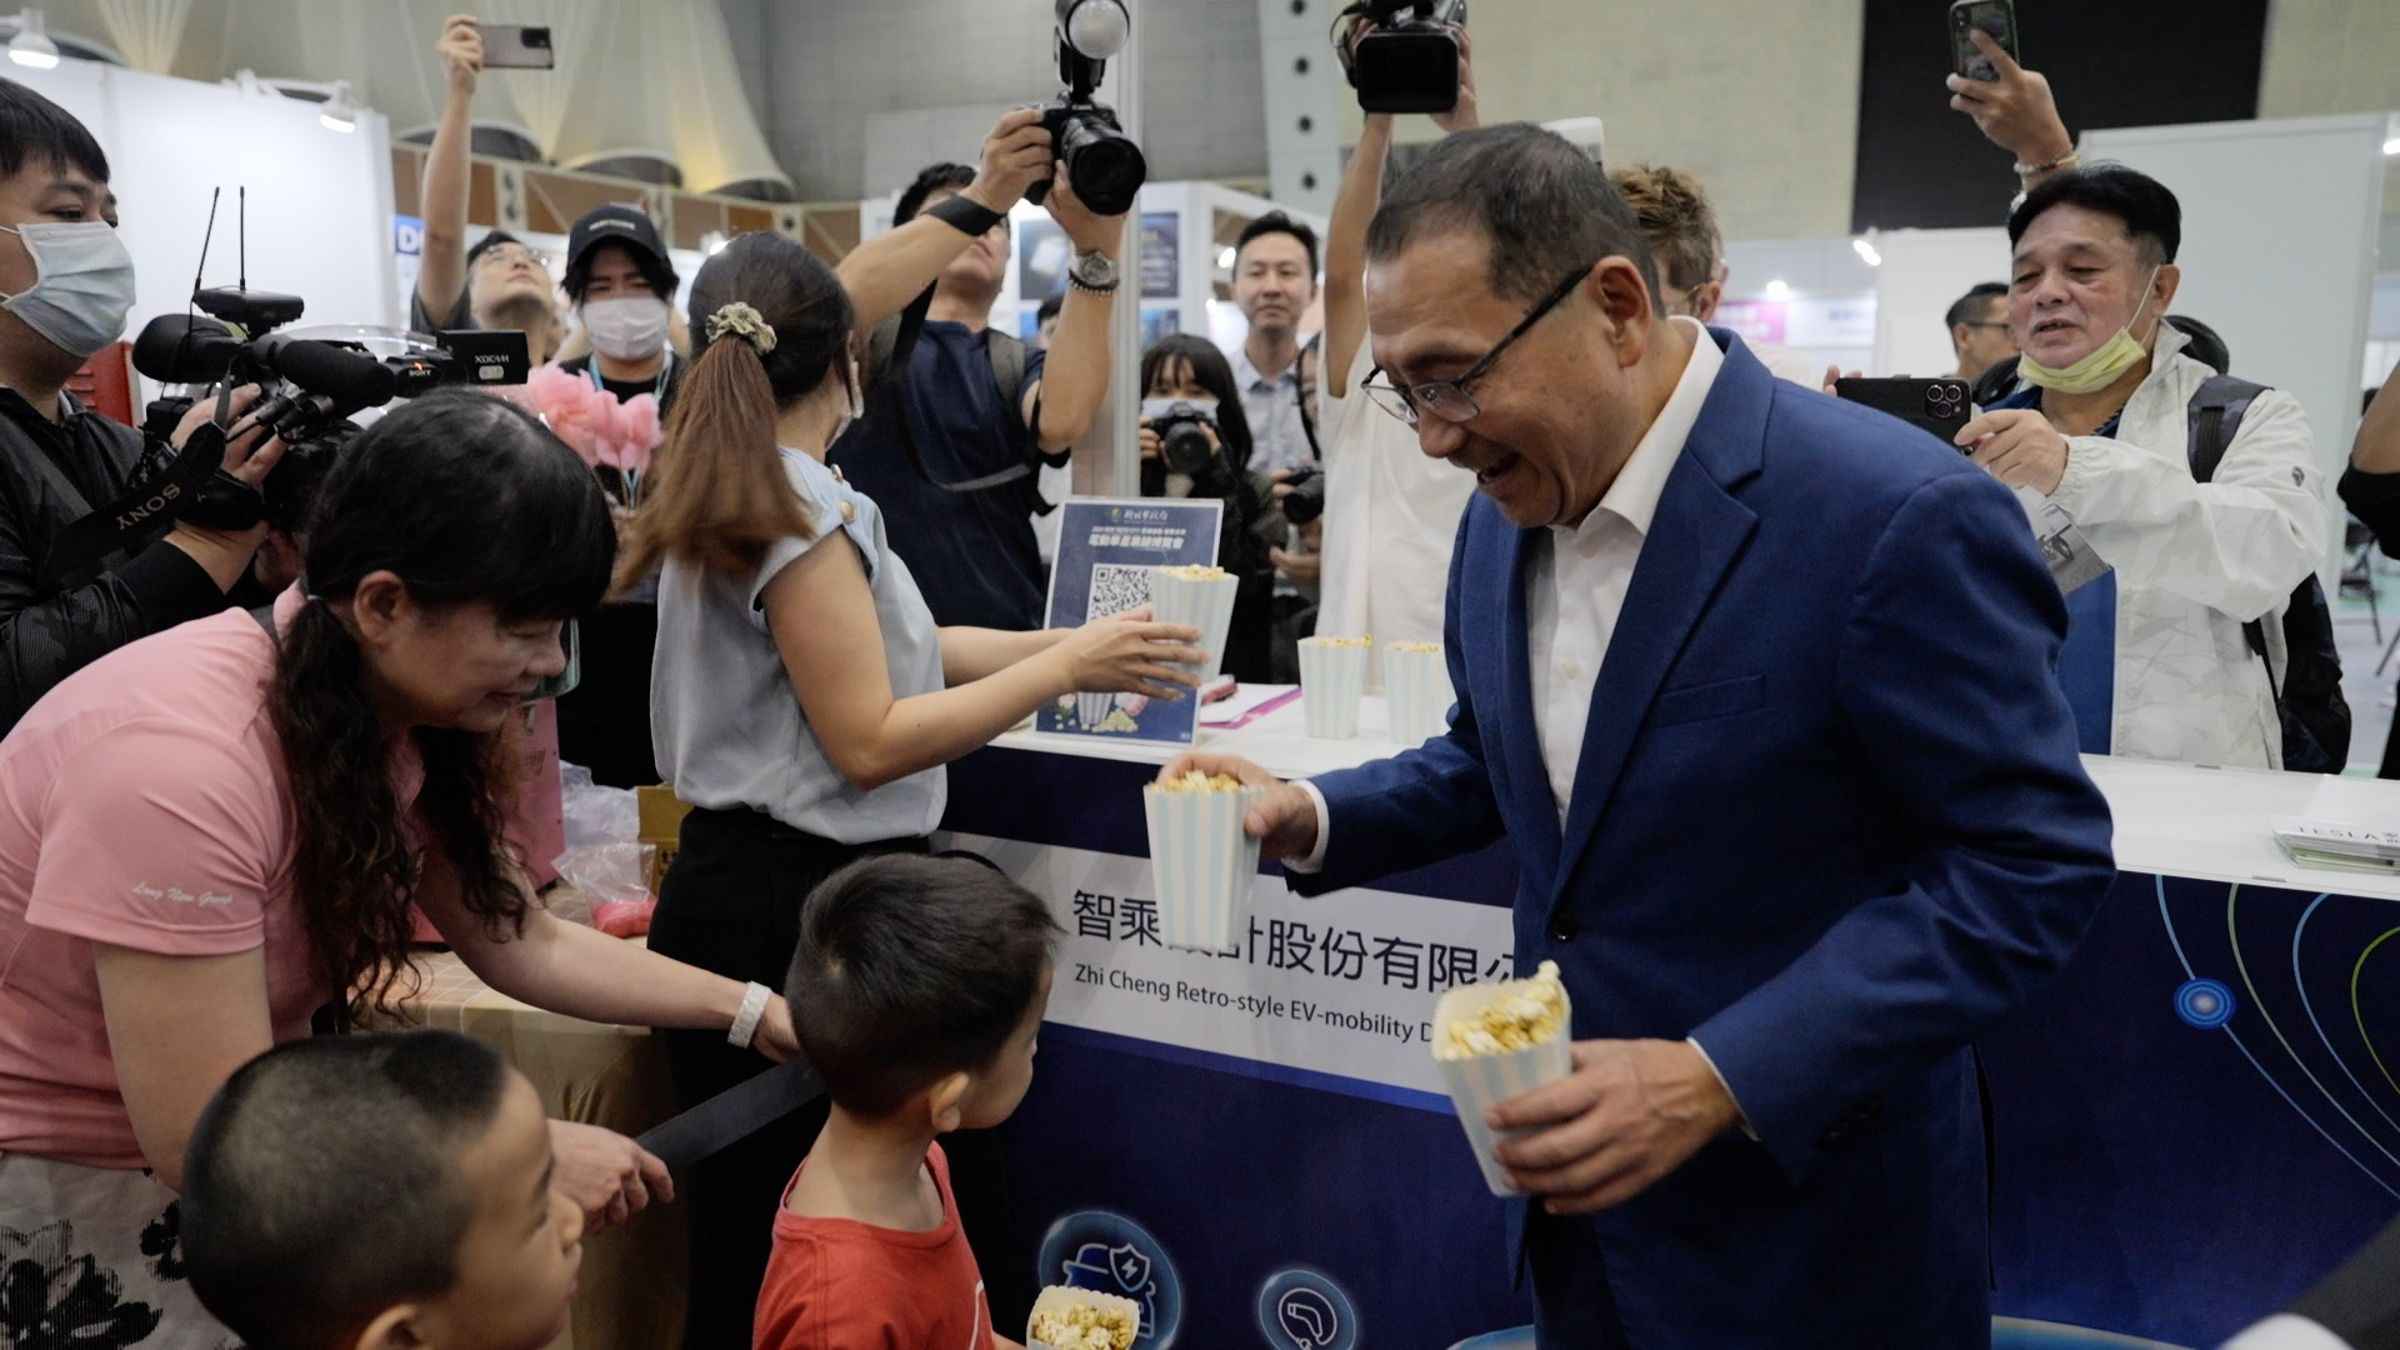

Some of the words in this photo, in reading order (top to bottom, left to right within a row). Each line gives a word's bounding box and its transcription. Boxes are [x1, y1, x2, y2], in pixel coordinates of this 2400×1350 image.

[116, 482, 180, 530] SONY
[1074, 963, 1105, 987] Zhi
[1109, 970, 1170, 1002] Cheng
[1176, 981, 1285, 1018] Retro-style
[1290, 1000, 1414, 1044] EV-mobility
